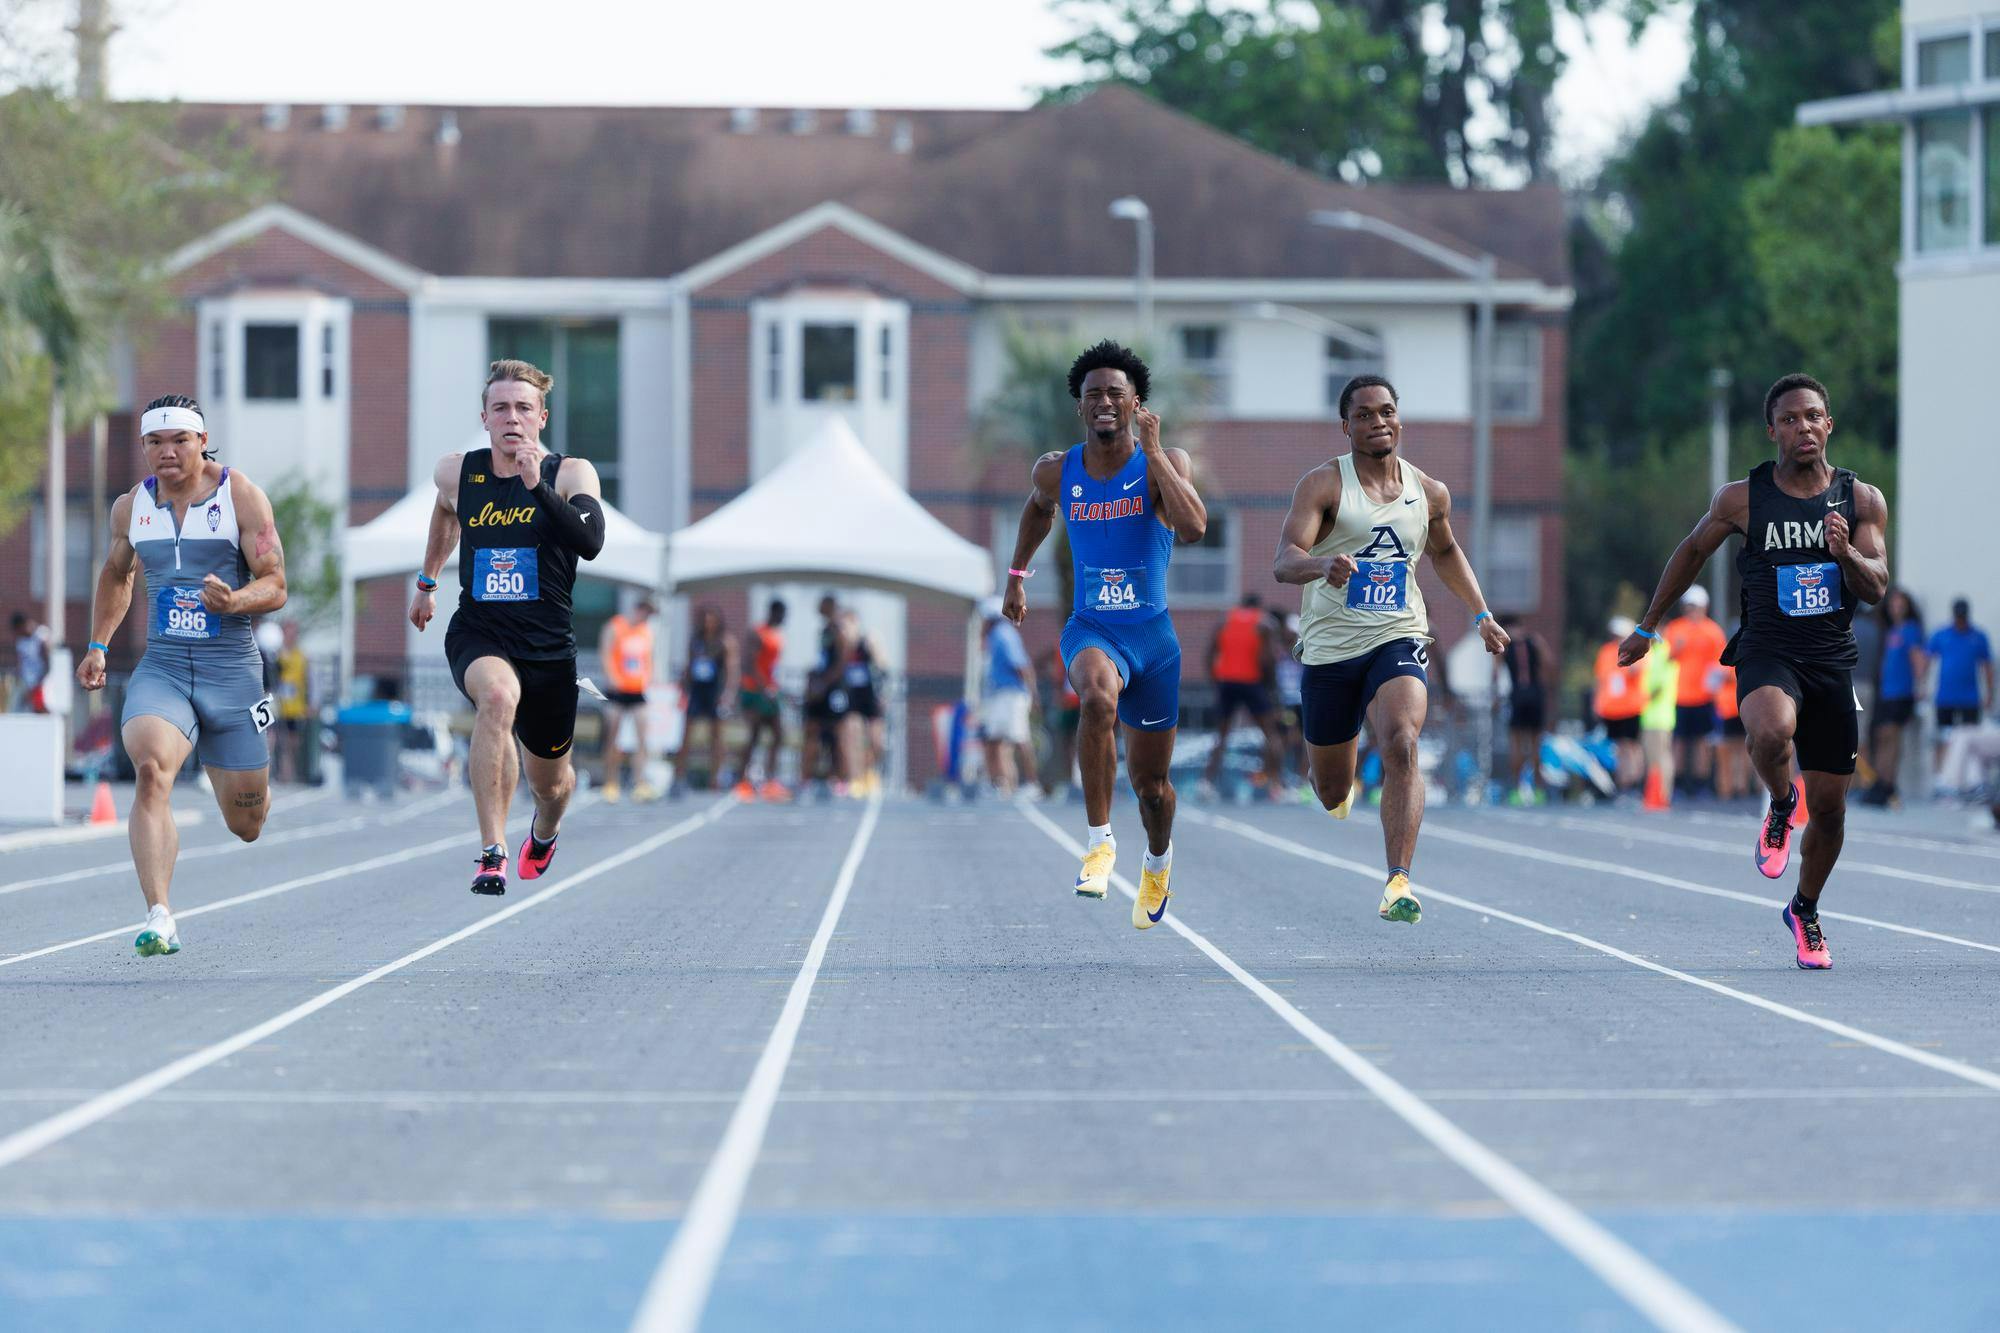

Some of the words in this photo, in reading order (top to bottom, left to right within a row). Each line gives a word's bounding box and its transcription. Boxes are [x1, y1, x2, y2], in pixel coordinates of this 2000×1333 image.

[1071, 485, 1083, 498] SEC
[469, 501, 536, 527] Iowa
[1069, 495, 1144, 521] FLORIDA
[1354, 526, 1409, 558] A
[1764, 520, 1825, 551] ARM
[486, 572, 525, 594] 650
[1098, 583, 1136, 605] 494
[1362, 584, 1397, 605] 102
[1792, 586, 1830, 609] 158
[168, 608, 207, 631] 986
[256, 700, 270, 728] 5
